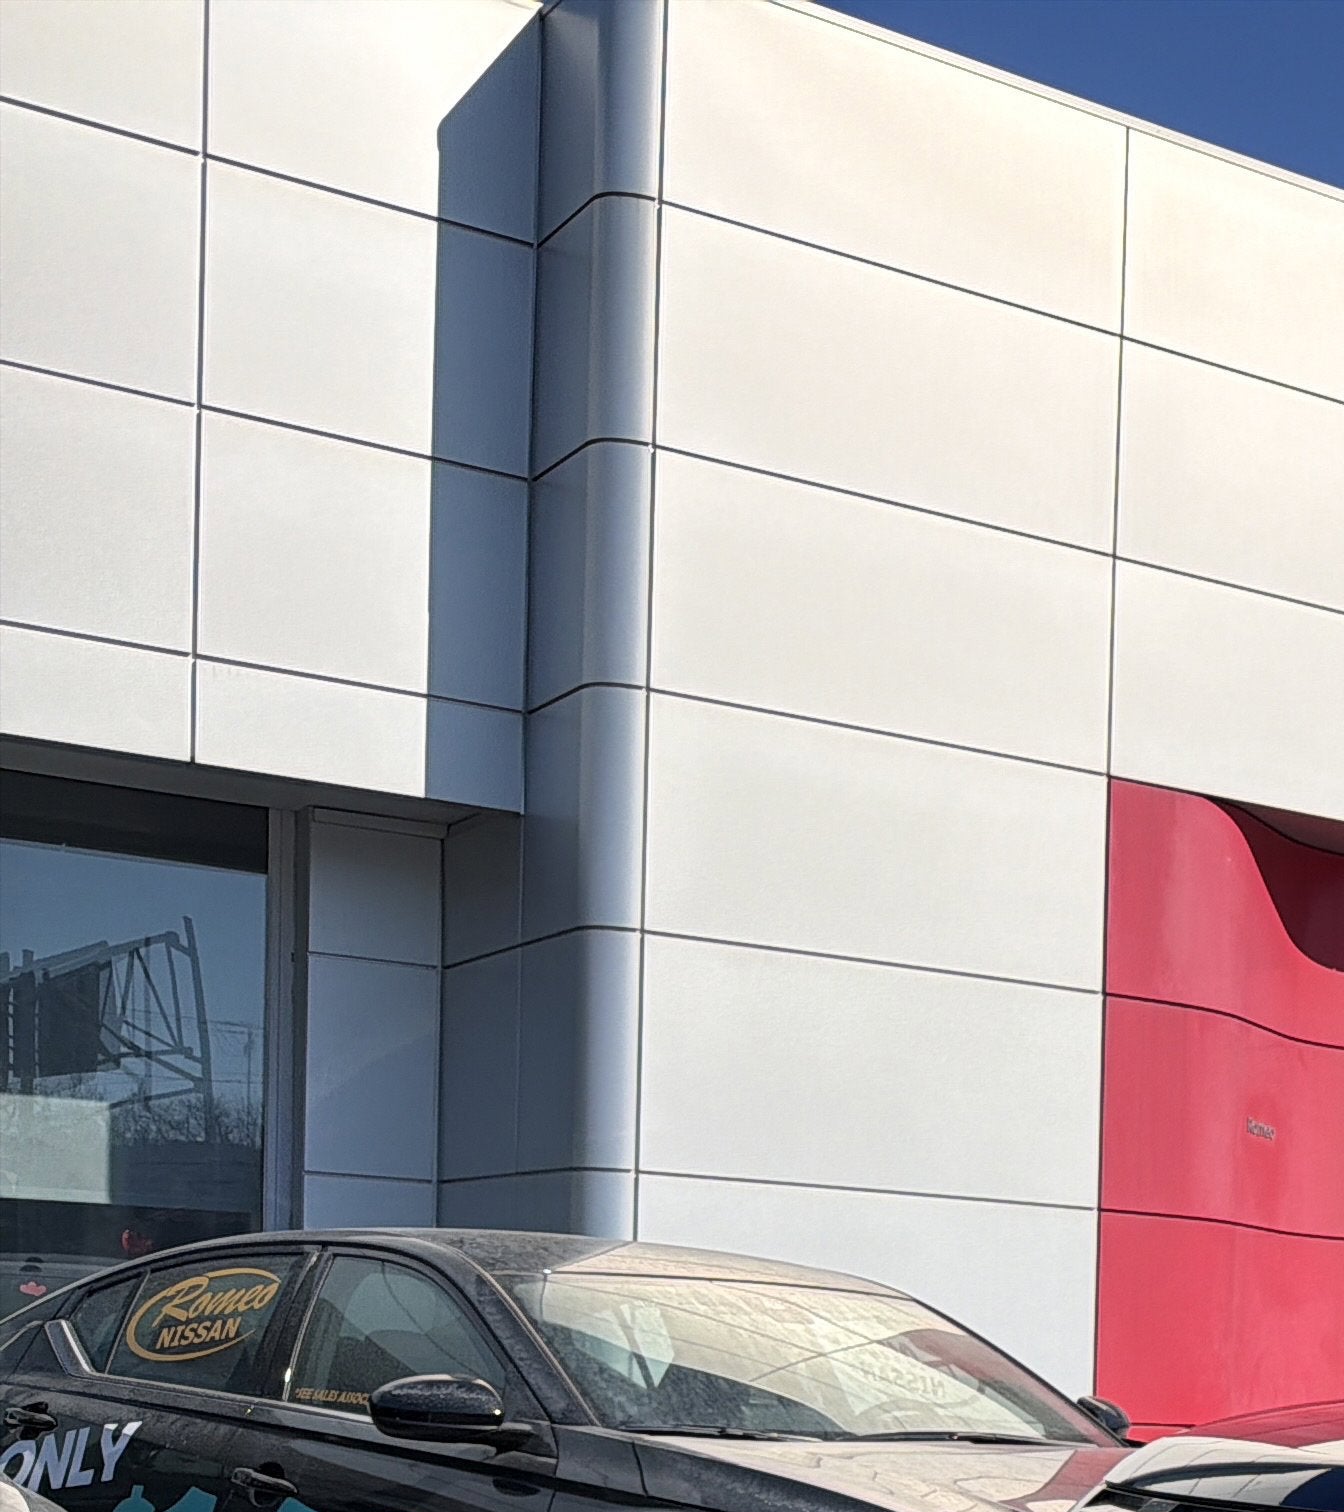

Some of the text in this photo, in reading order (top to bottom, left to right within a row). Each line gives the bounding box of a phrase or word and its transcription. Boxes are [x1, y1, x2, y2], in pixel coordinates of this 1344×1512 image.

[152, 1276, 281, 1327] Romeo
[155, 1317, 241, 1349] NISSAN
[0, 1421, 143, 1493] ONLY
